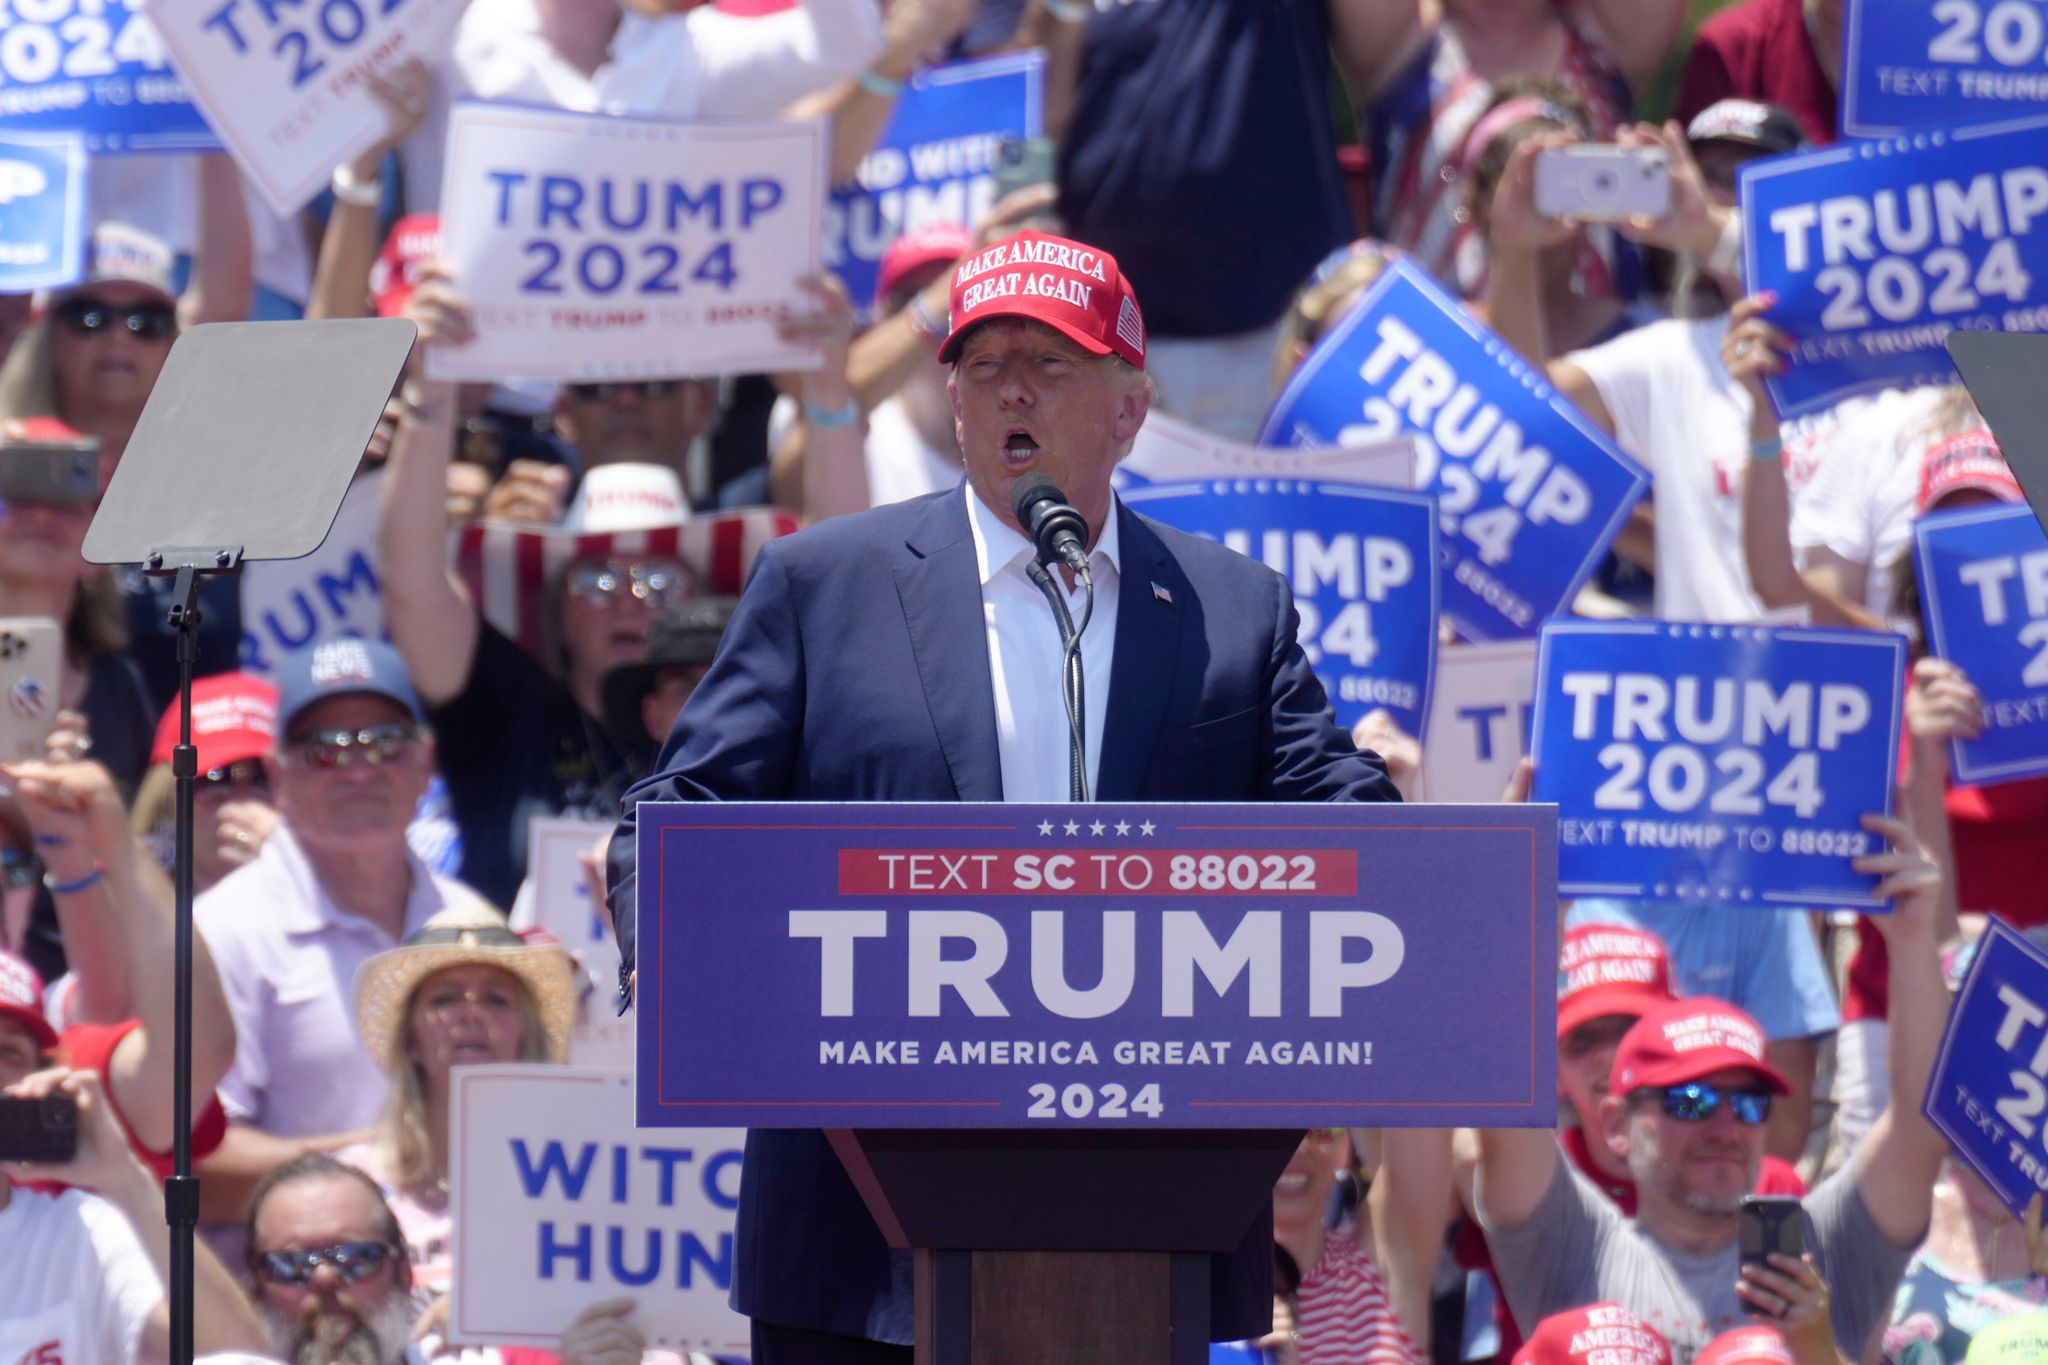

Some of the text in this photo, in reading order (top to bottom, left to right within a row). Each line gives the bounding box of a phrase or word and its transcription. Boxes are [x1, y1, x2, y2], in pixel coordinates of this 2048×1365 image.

[0, 14, 168, 84] 024
[272, 0, 406, 88] 20
[1927, 0, 2048, 66] 20
[1877, 66, 1949, 96] TEXT
[486, 170, 785, 234] TRUMP
[1769, 166, 2048, 272] TRUMP
[520, 239, 738, 296] 2024
[955, 240, 1106, 288] MAKE AMERICA
[962, 272, 1092, 313] GREAT AGAIN
[1814, 238, 2031, 332] 2024
[2003, 304, 2048, 333] 880
[1358, 314, 1592, 526] TRUMP
[239, 551, 383, 672] RUM
[1294, 597, 1380, 668] 24
[1339, 674, 1416, 710] 88022
[1561, 672, 1871, 751] TRUMP
[1594, 742, 1825, 818] 2024
[1621, 821, 1725, 848] TRUMP
[1732, 828, 1774, 853] TO
[1781, 829, 1871, 857] 88022
[879, 854, 1317, 891] TEXT SC TO 88022
[788, 910, 1405, 1019] TRUMP
[1600, 959, 1654, 984] AGAIN
[819, 1041, 1374, 1065] MAKE AMERICA GREAT AGAIN!
[1672, 1030, 1724, 1053] GREAT
[1027, 1083, 1164, 1119] 2024
[1955, 1085, 2004, 1145] TEXT
[2008, 1141, 2048, 1192] TRU
[508, 1138, 747, 1211] WITC
[538, 1221, 736, 1290] HUN
[1569, 1327, 1667, 1358] AMERICA
[1587, 1349, 1656, 1365] GREA
[1998, 1337, 2048, 1355] TRUM
